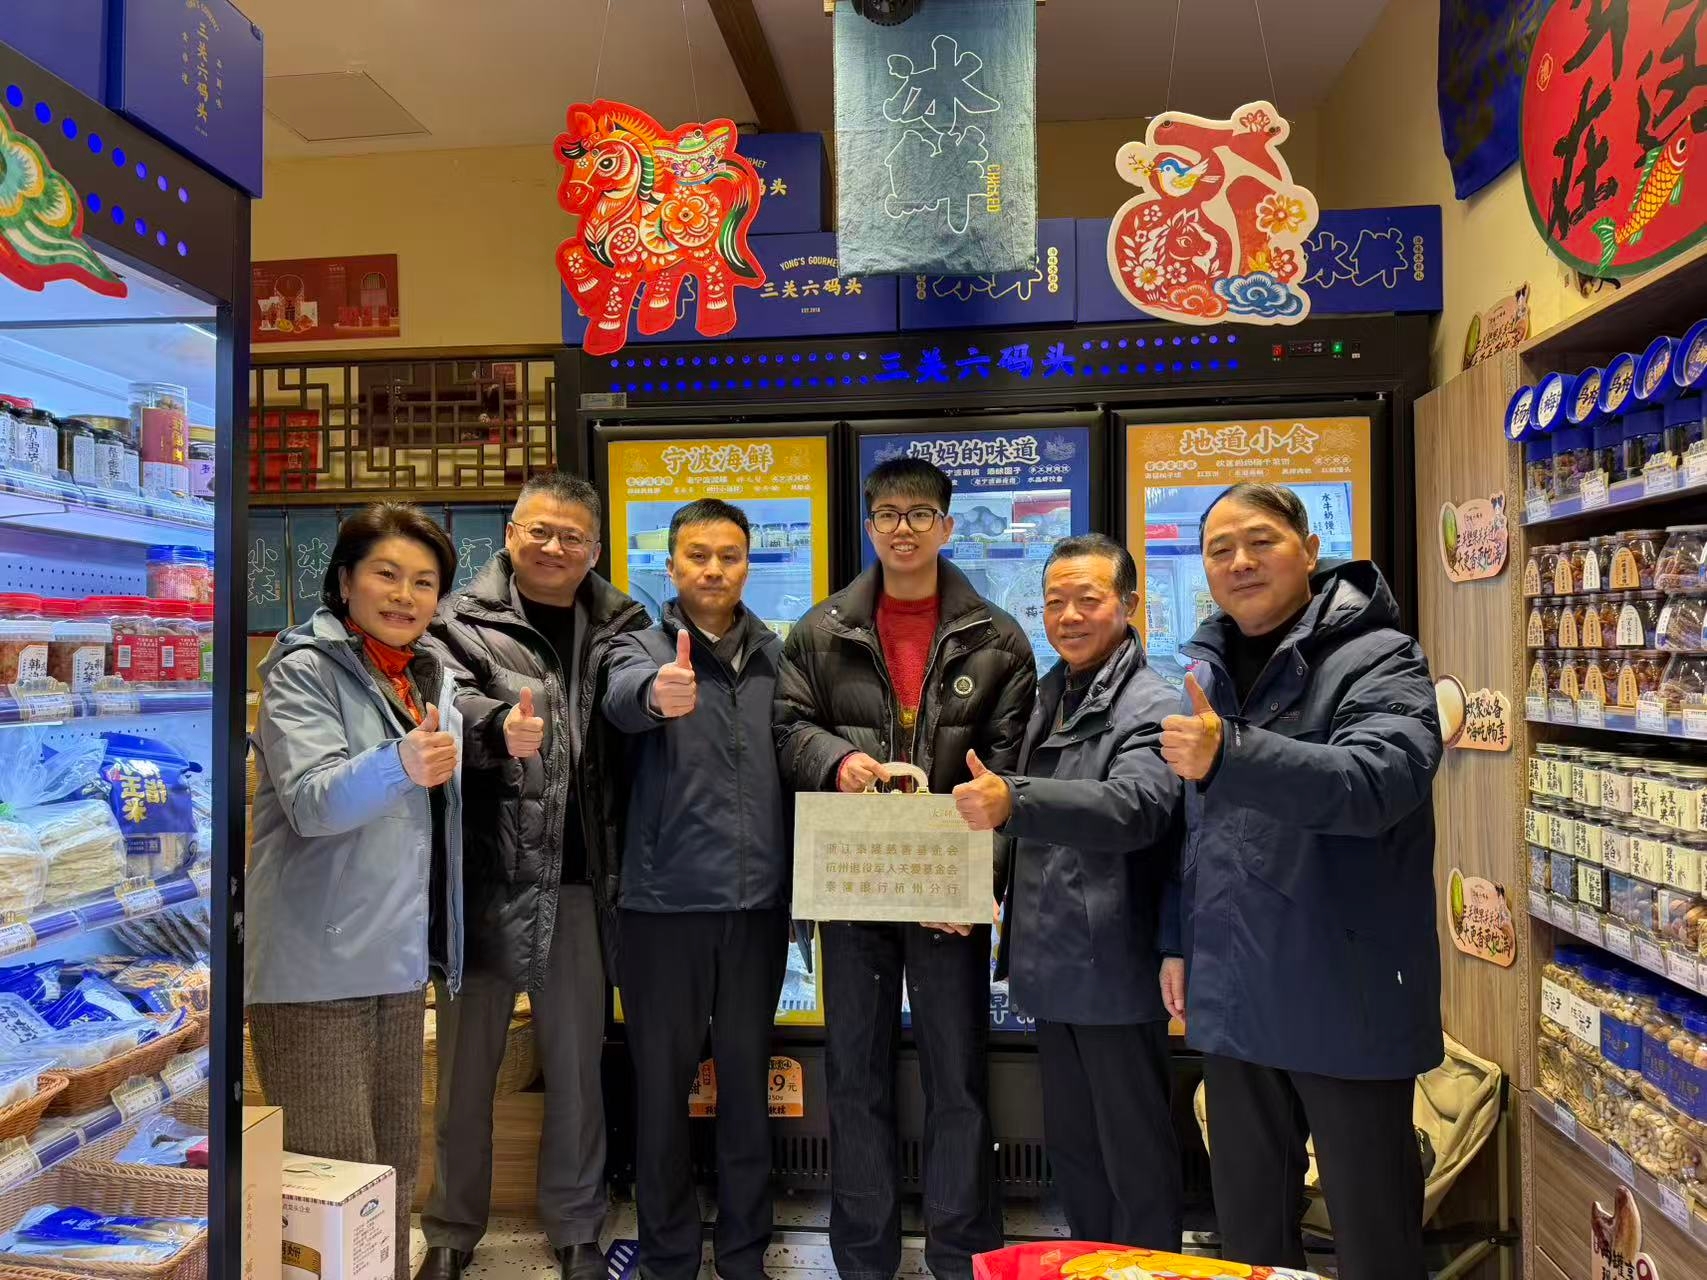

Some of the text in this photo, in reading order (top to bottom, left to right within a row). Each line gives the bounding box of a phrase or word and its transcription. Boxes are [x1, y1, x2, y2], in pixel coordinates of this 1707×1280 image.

[779, 256, 806, 271] YONG'S
[760, 277, 863, 298] 三关六码头
[874, 342, 1077, 384] 三关六码头
[906, 436, 1040, 466] 妈妈的味道
[1180, 424, 1319, 456] 地道小食
[661, 444, 774, 474] 宁波海鲜
[1466, 697, 1503, 719] 欢聚必备
[1467, 720, 1507, 745] 嗨吃畅享
[825, 843, 959, 858] 浙江泰隆慈善基金会
[824, 881, 959, 896] 泰隆银行杭州分行
